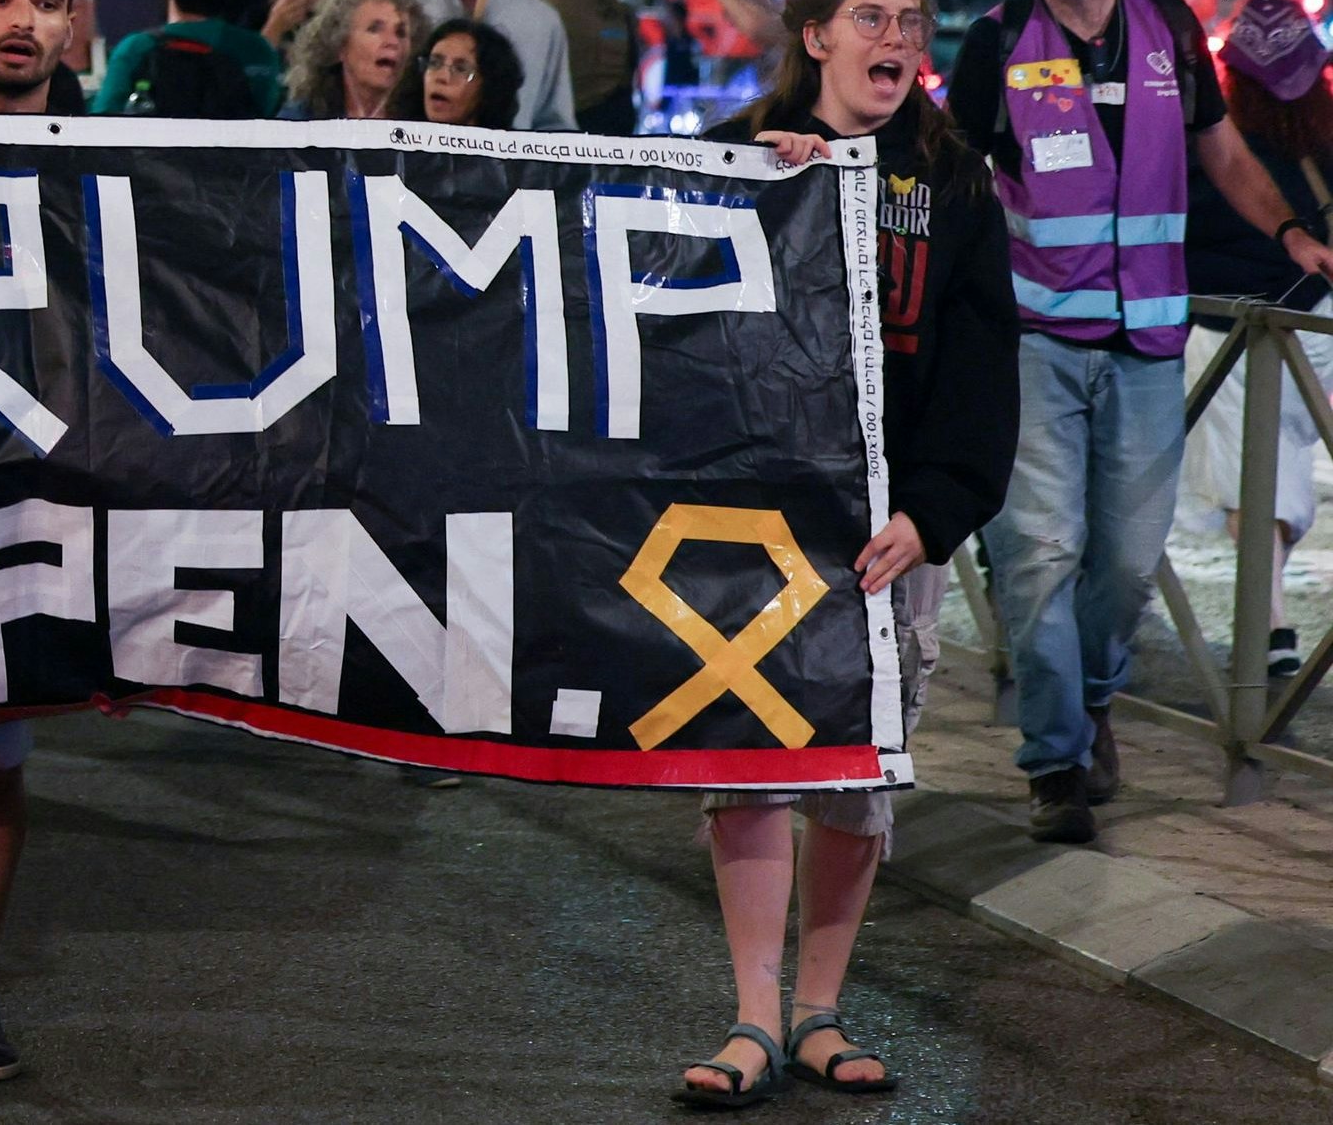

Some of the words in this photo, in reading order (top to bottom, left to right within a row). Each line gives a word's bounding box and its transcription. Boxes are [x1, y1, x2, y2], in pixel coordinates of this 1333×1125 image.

[438, 134, 494, 153] מנצחים
[498, 139, 517, 155] רק
[522, 141, 570, 161] שכולם
[575, 145, 625, 161] חוזרים
[640, 149, 704, 168] 500x100
[854, 169, 867, 194] טה
[854, 208, 869, 265] מנצחים
[880, 206, 931, 237] אותם
[863, 345, 877, 397] חוזרים
